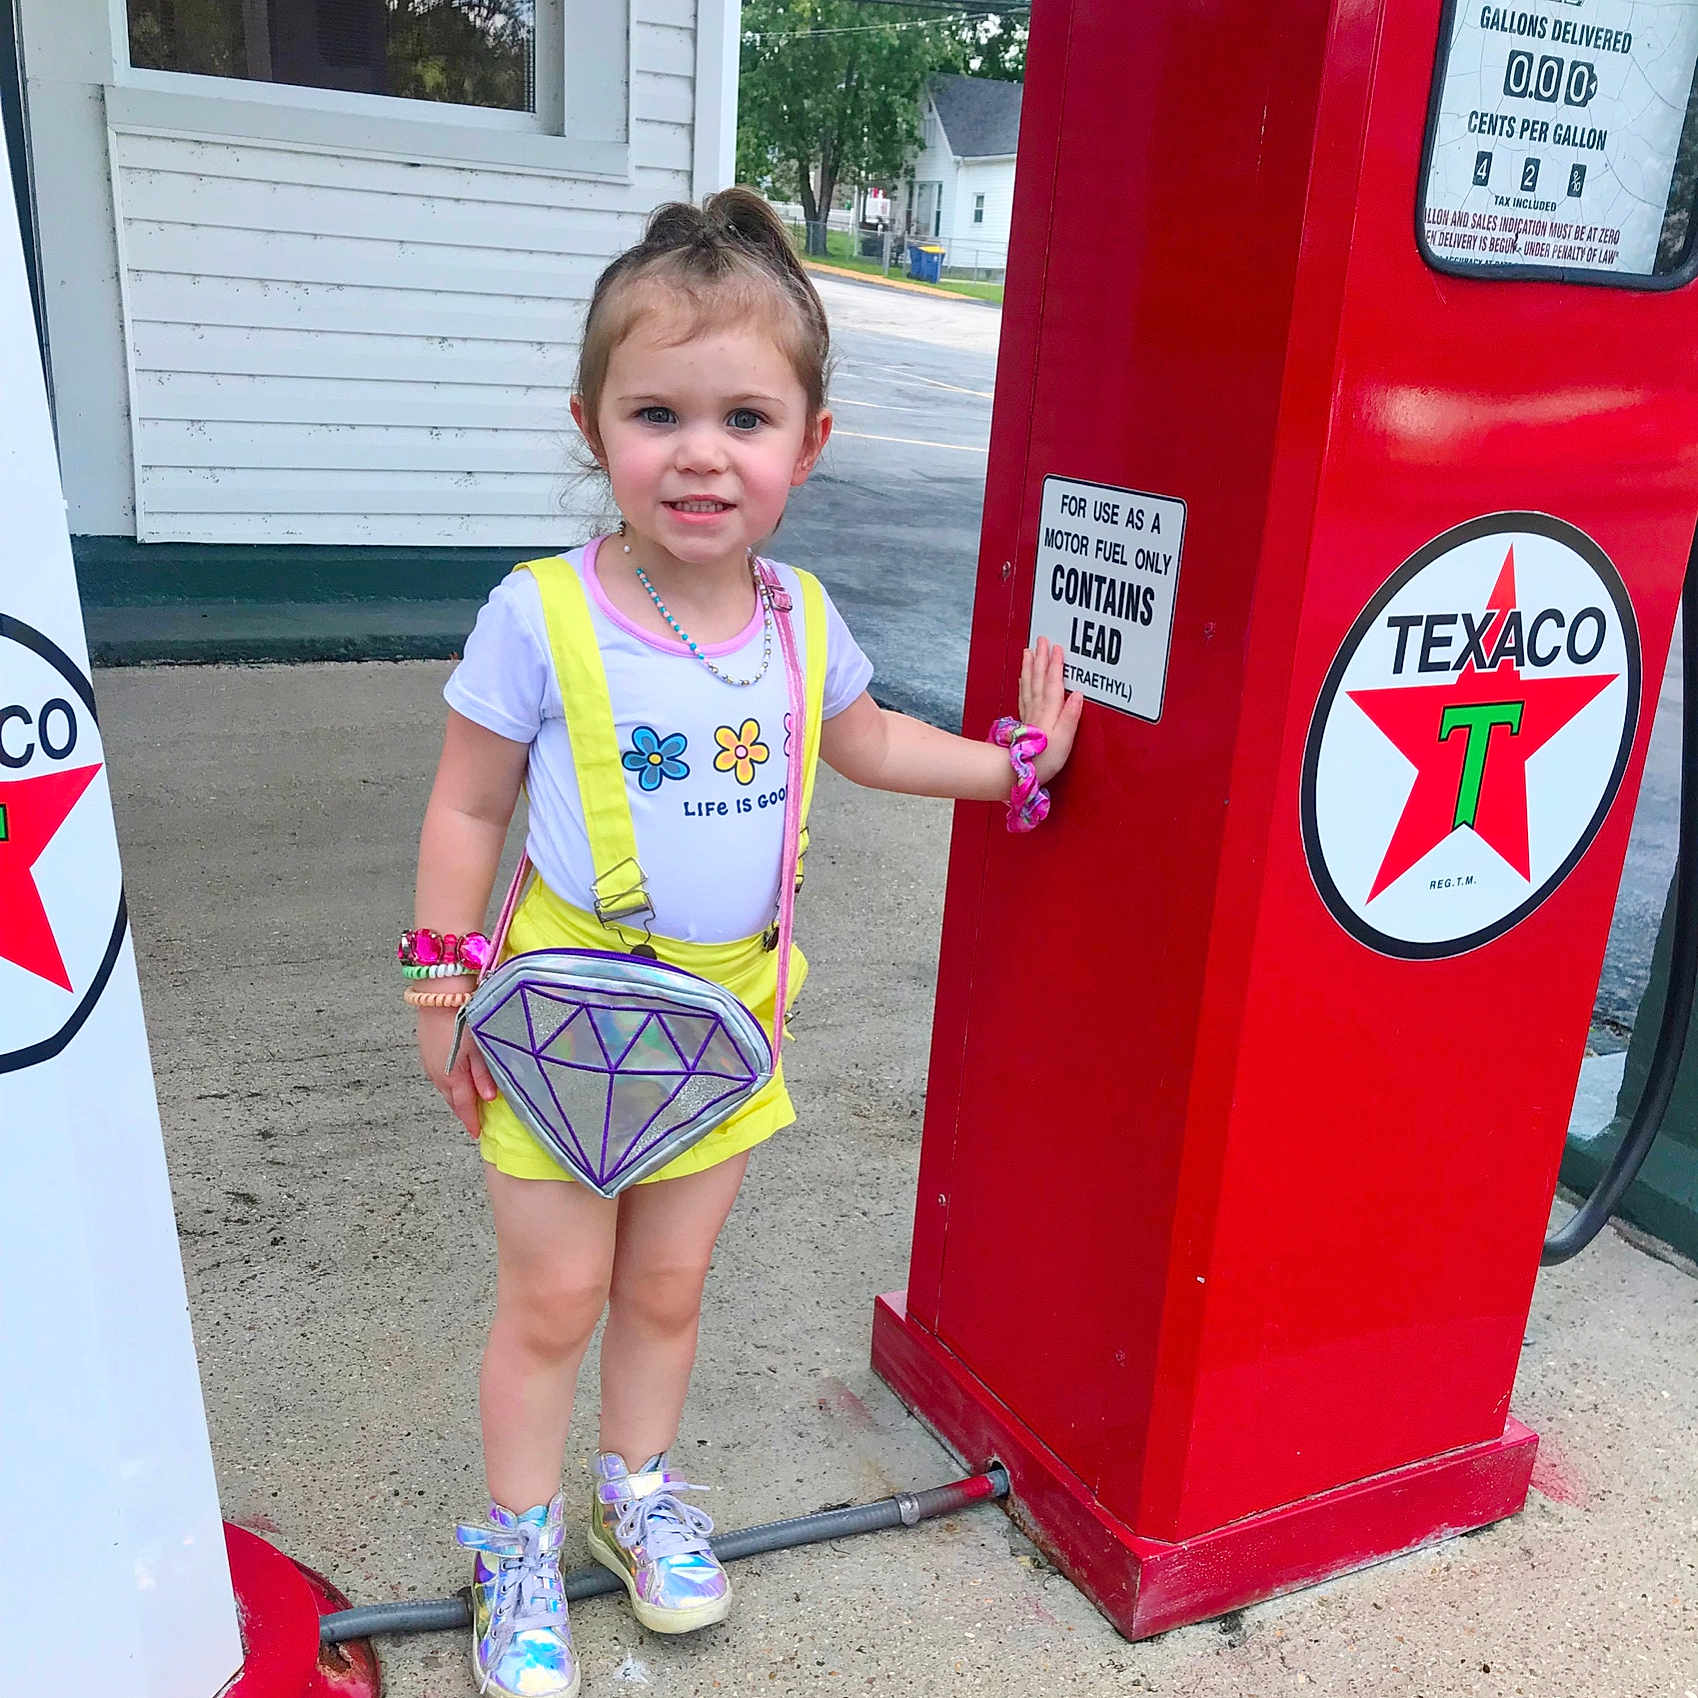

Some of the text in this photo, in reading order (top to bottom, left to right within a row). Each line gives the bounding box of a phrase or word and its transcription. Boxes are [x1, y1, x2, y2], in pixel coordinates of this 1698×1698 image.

[1480, 5, 1633, 54] GALLONS DELIVERED
[1467, 110, 1607, 151] CENTS PER GALLON
[1494, 195, 1557, 212] TAX INCLUDED
[1426, 229, 1438, 247] EN
[1438, 231, 1478, 252] DELIVERY
[1478, 235, 1488, 252] IS
[1523, 240, 1550, 259] UNDER
[1551, 243, 1586, 262] PENALTY
[1586, 247, 1598, 264] OF
[1450, 210, 1470, 228] AND
[1471, 212, 1498, 231] SALES
[1499, 216, 1547, 238] INDICATION
[1548, 221, 1573, 240] MUST
[1574, 224, 1587, 241] BE
[1586, 226, 1598, 243] AT
[1597, 227, 1621, 246] ZERO
[1060, 494, 1161, 534] FOR USE AS A
[1044, 527, 1172, 576] MOTOR FUEL ONLY
[1051, 564, 1155, 626] CONTAINS
[1070, 616, 1122, 666] LEAD
[1386, 606, 1607, 675] TEXACO
[1063, 662, 1132, 703] ETRAETHYL)
[0, 697, 78, 769] CO
[1438, 700, 1524, 832] T
[736, 798, 753, 814] IS
[757, 783, 788, 809] GOO
